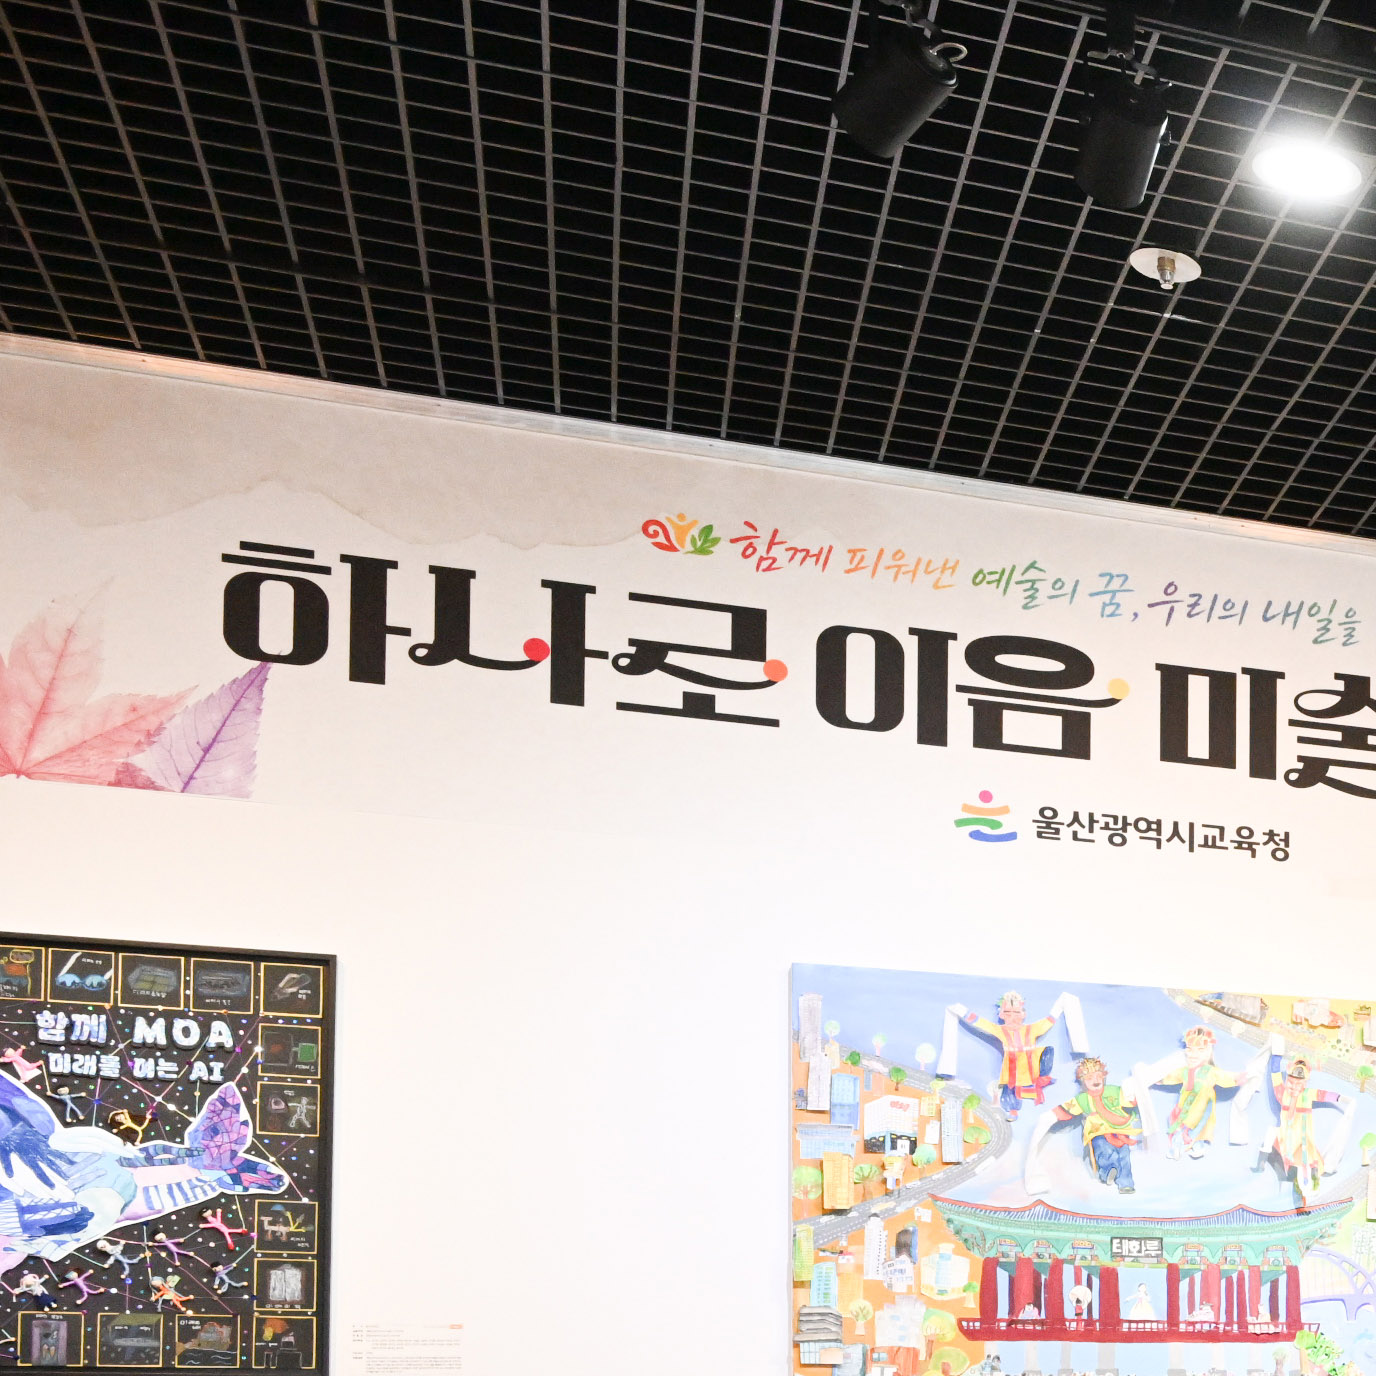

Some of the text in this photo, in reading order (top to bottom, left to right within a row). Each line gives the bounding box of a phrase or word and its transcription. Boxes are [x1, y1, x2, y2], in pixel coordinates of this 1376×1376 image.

[729, 520, 834, 573] 함께
[843, 547, 960, 591] 피워낸
[971, 559, 1080, 611] 예술의
[1087, 571, 1138, 624] 꿈,
[1147, 580, 1249, 627] 우리의
[1261, 598, 1361, 647] 내일을
[1032, 806, 1291, 862] 울산광역시교육청
[36, 1010, 234, 1050] 함께 MOA
[48, 1053, 121, 1079] 미래를
[188, 1061, 225, 1084] AI
[1112, 1238, 1162, 1257] 태화루
